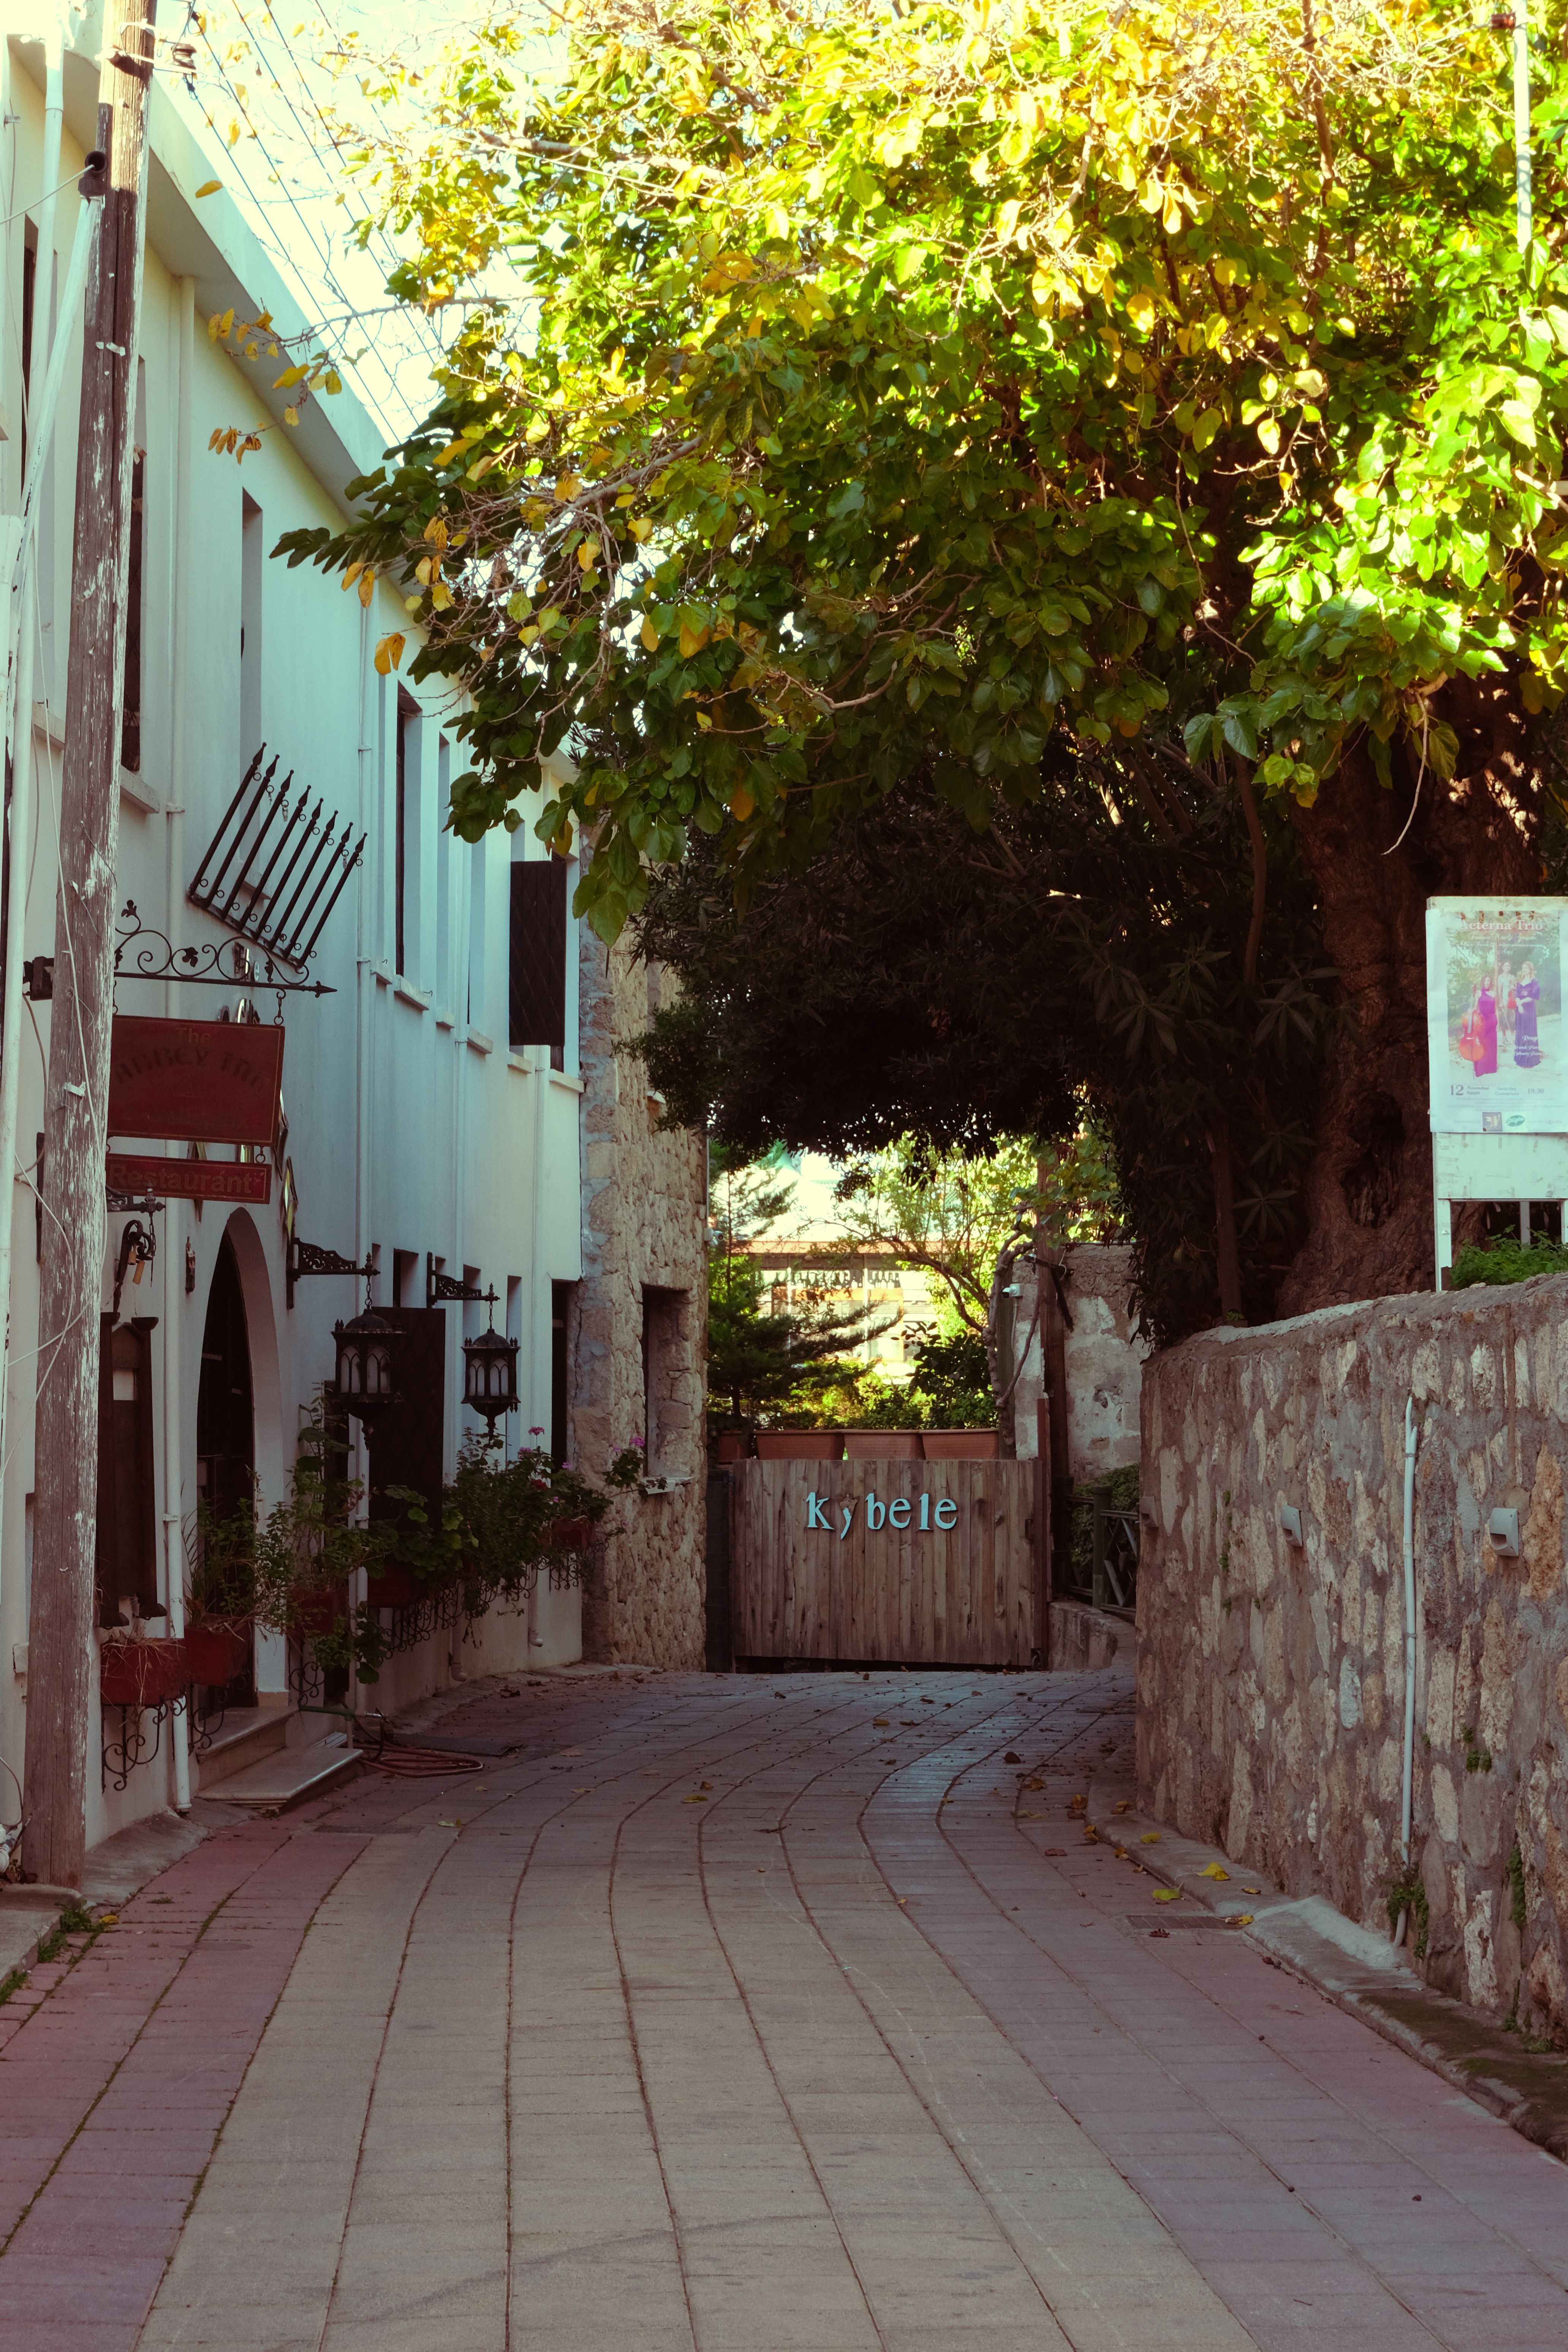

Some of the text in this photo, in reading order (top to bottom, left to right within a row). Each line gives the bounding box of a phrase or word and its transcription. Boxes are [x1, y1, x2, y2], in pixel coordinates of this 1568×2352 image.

[1460, 920, 1543, 931] Aeterna Trio
[175, 1027, 212, 1044] The
[1450, 1084, 1464, 1096] 12
[109, 1163, 253, 1195] Restaurant
